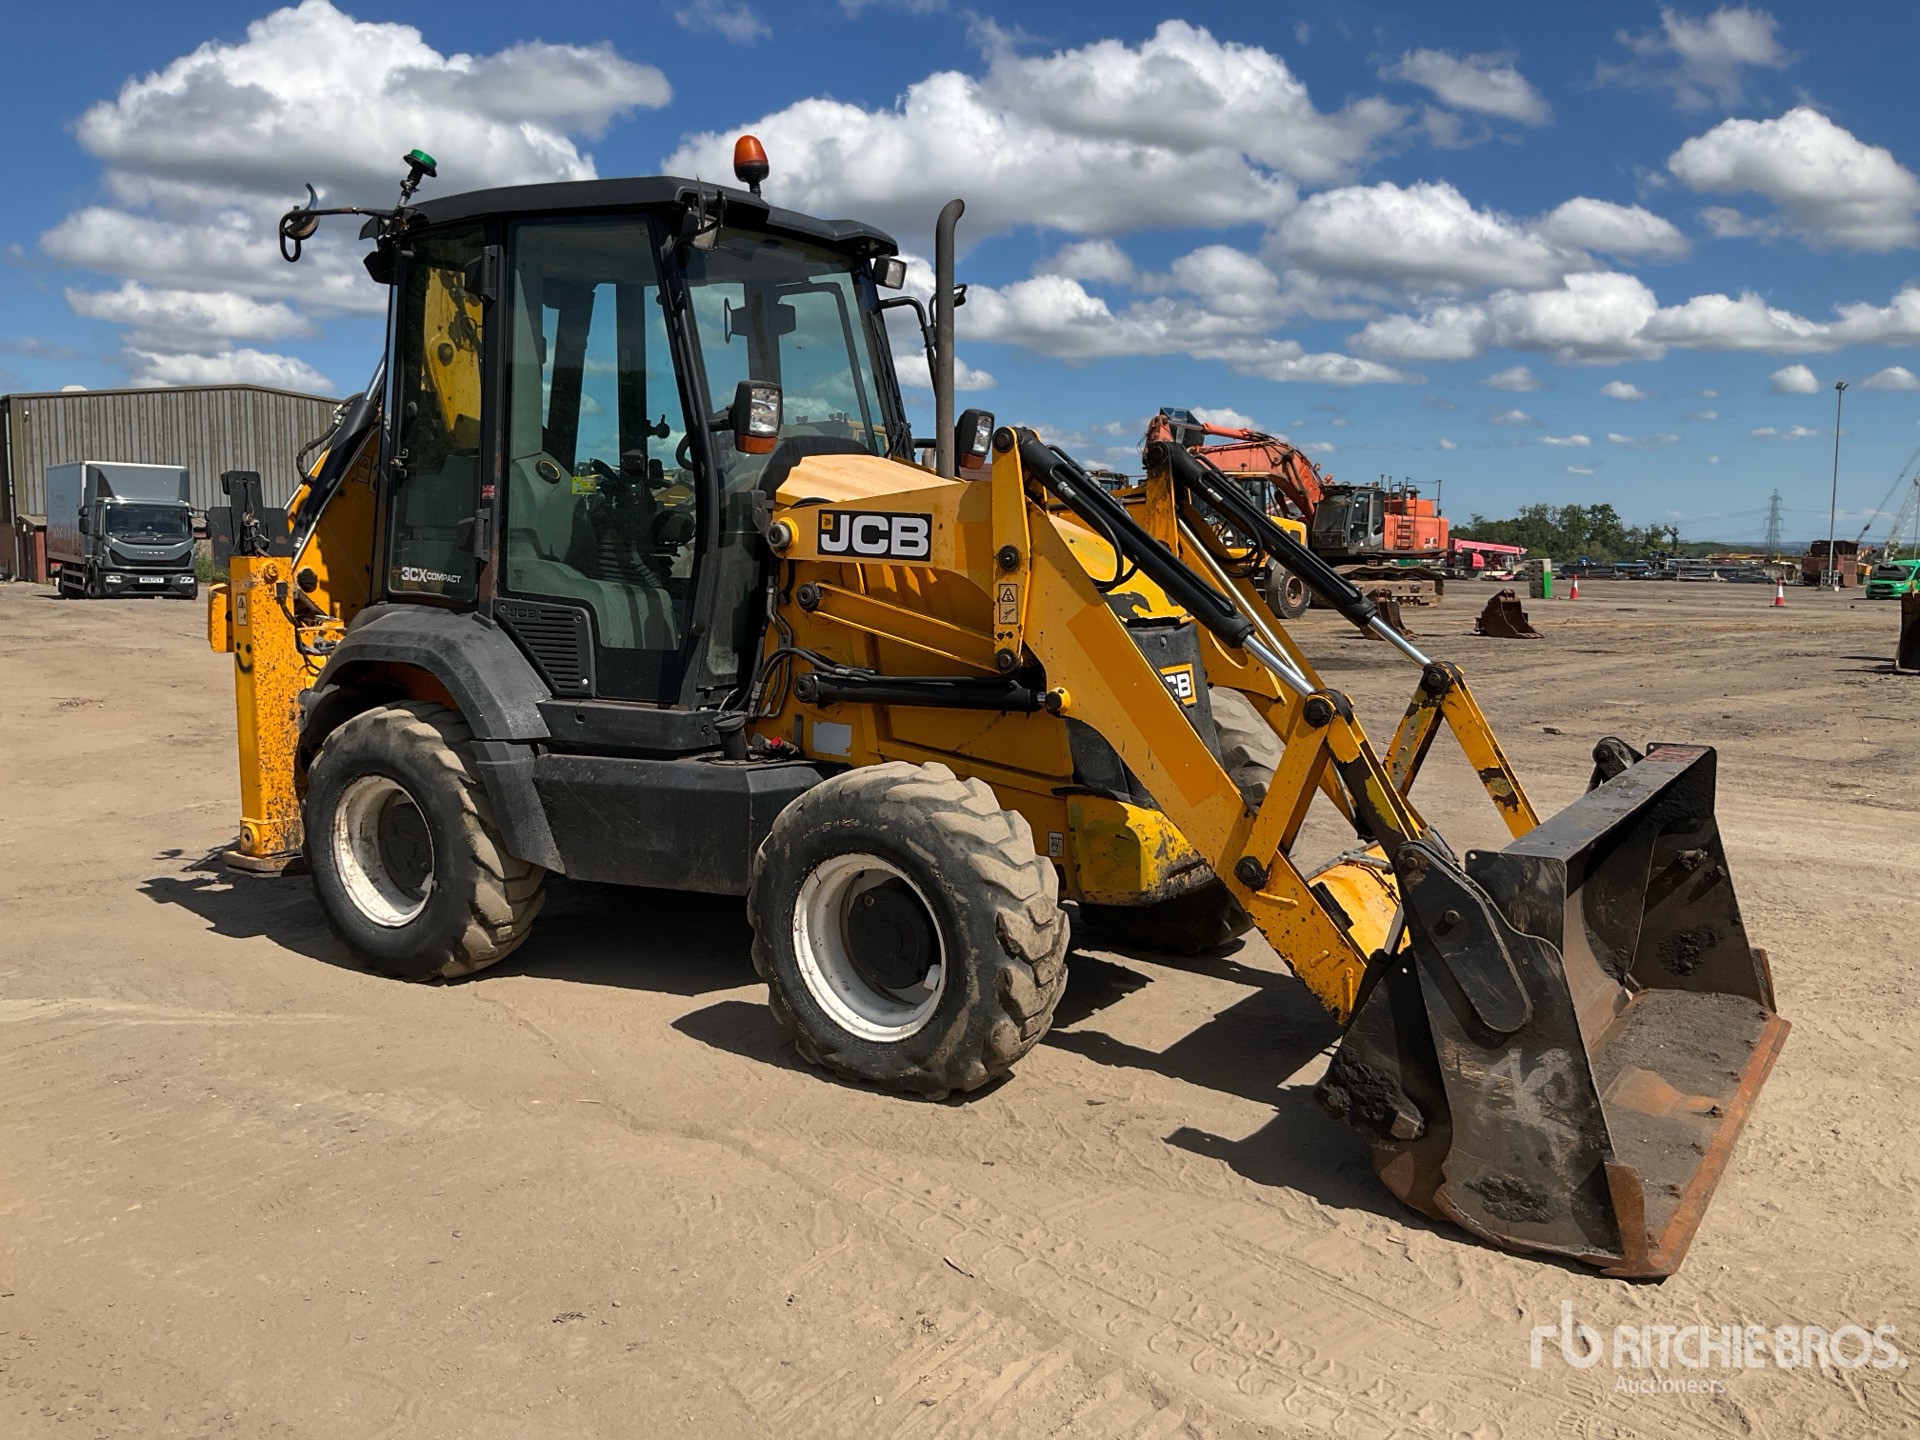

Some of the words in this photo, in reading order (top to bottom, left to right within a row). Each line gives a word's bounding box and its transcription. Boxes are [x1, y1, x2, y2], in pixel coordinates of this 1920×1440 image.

[821, 514, 929, 557] JCB
[401, 566, 427, 582] 3CX
[427, 572, 461, 583] COMPACT
[508, 608, 537, 619] JCB
